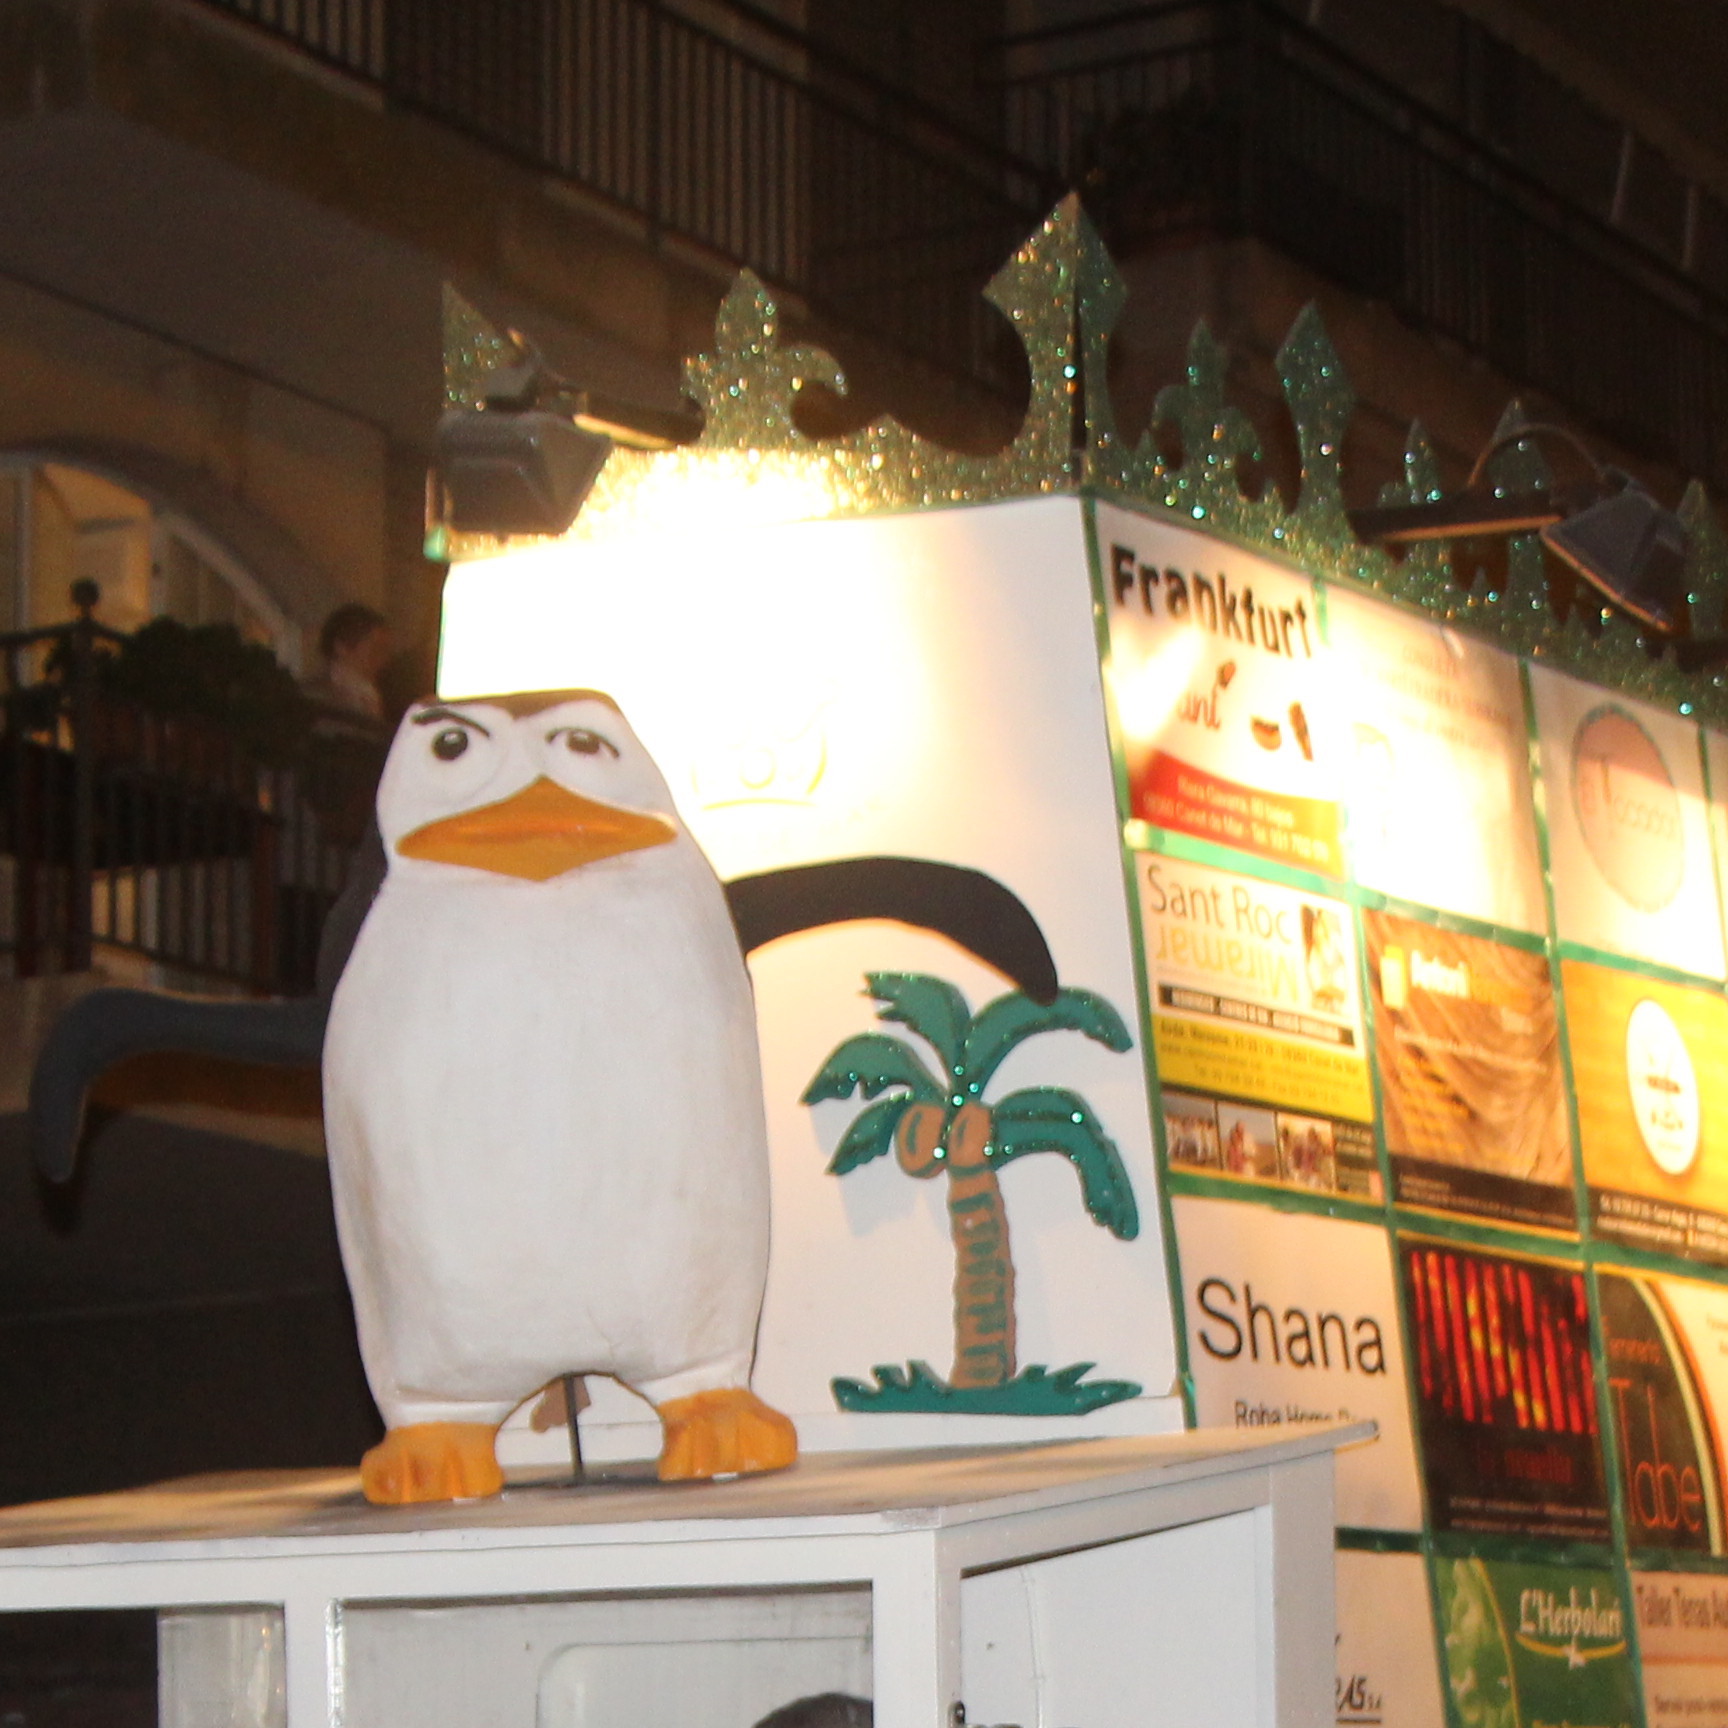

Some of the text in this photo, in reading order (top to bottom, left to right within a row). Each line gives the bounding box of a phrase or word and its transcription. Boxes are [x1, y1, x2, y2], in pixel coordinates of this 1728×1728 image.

[1111, 543, 1312, 659] Frankfurt
[1147, 864, 1293, 945] Sant Roc
[1196, 1277, 1387, 1376] Shana
